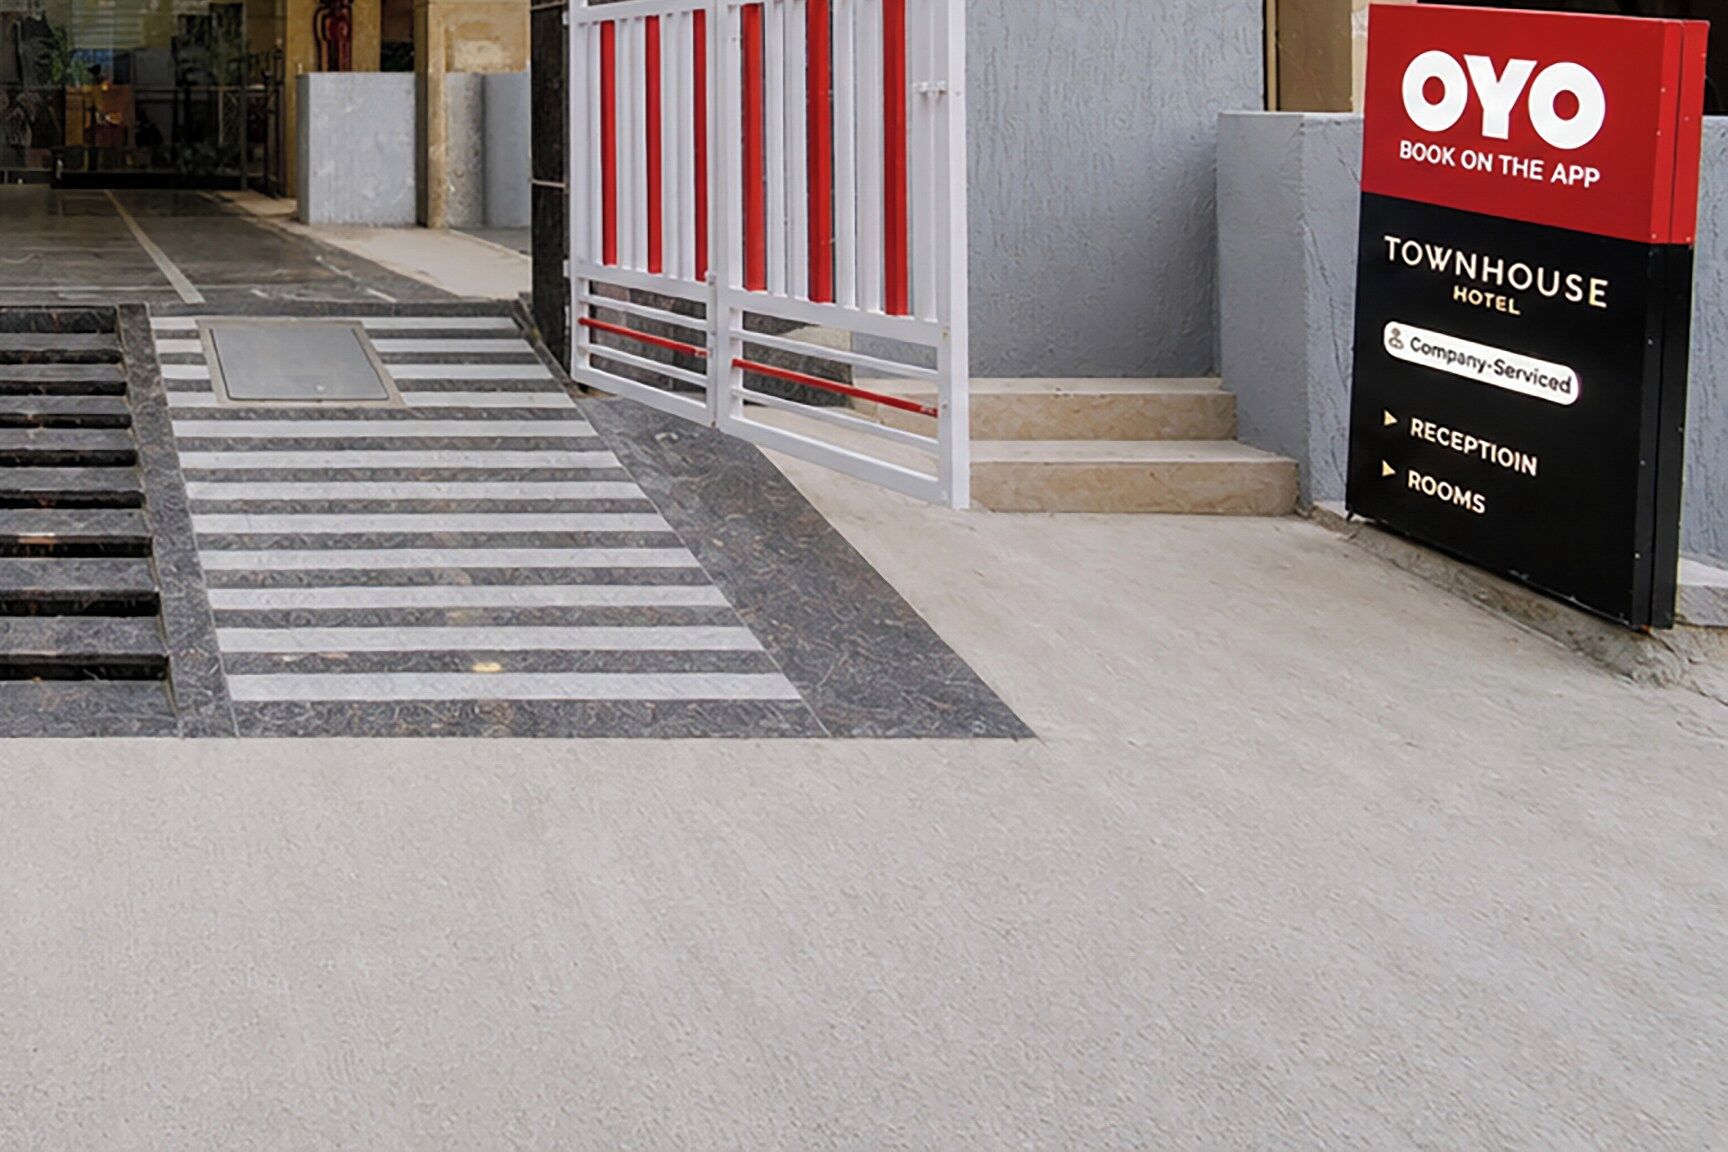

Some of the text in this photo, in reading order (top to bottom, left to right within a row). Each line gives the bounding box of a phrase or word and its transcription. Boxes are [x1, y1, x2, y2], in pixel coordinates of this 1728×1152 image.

[1401, 50, 1606, 150] OYO
[1399, 139, 1601, 189] BOOK ON THE APP
[1383, 235, 1609, 308] TOWNHOUSE
[1453, 285, 1521, 315] HOTEL
[1410, 336, 1572, 395] Company-Serviced
[1407, 469, 1487, 515] ROOMS
